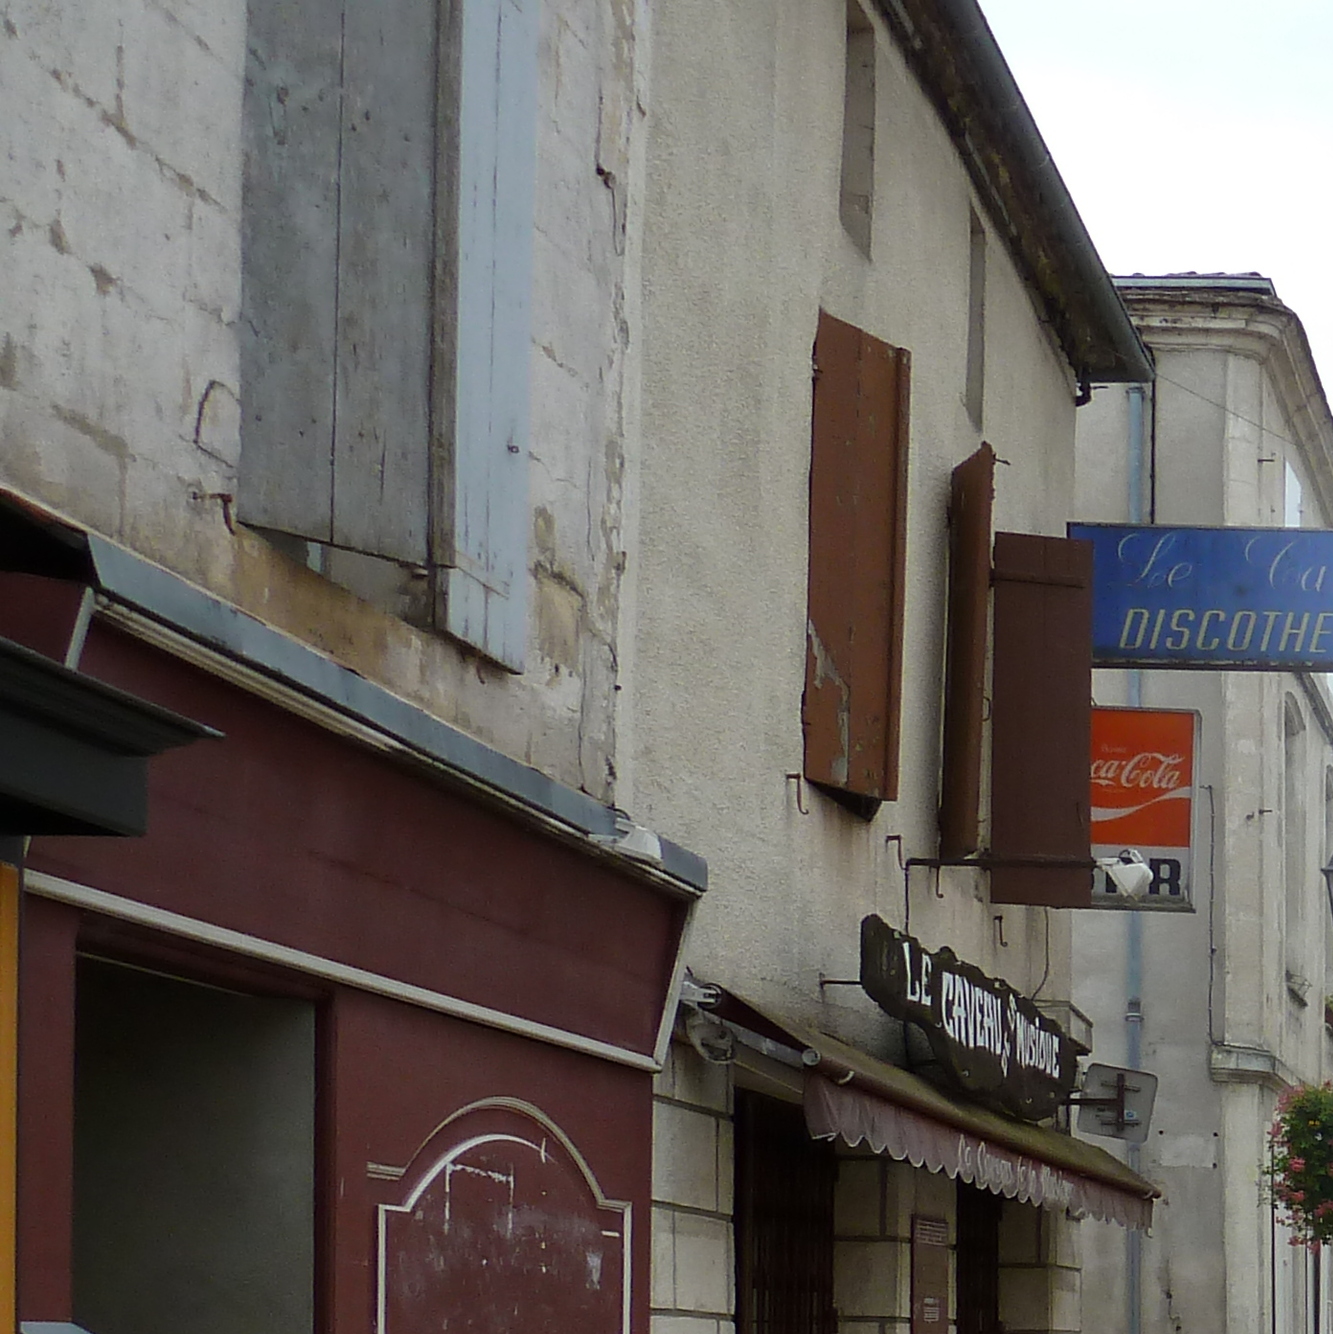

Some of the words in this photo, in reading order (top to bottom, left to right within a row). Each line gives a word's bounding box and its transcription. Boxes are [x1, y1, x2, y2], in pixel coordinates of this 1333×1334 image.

[1116, 533, 1193, 589] Le
[1090, 752, 1186, 789] ca-Cola
[902, 941, 932, 1006] LE
[941, 970, 1003, 1056] CAVEAU
